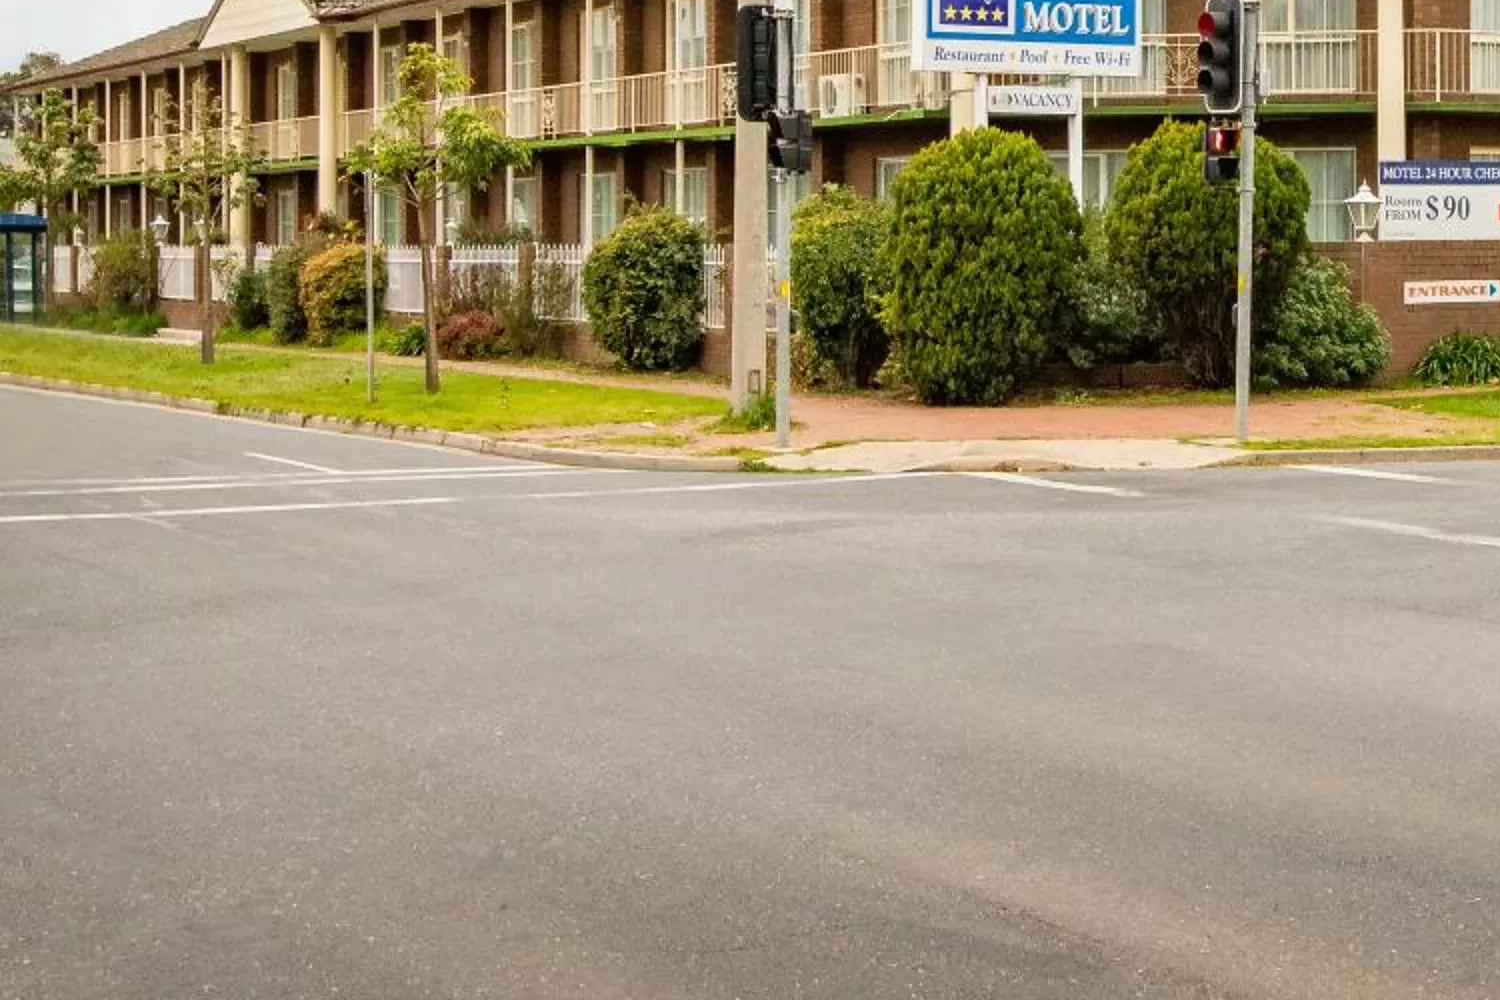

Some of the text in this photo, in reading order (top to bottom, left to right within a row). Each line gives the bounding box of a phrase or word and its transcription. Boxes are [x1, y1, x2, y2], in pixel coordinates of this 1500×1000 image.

[1023, 1, 1129, 36] MOTEL
[934, 46, 1131, 67] Restaurant Pool Free Wi-Fi
[1013, 93, 1073, 108] VACANCY
[1383, 168, 1425, 179] MOTEL
[1425, 168, 1437, 179] 24
[1438, 168, 1473, 180] HOUR
[1385, 209, 1422, 221] FROM
[1408, 285, 1486, 298] ENTRANCE
